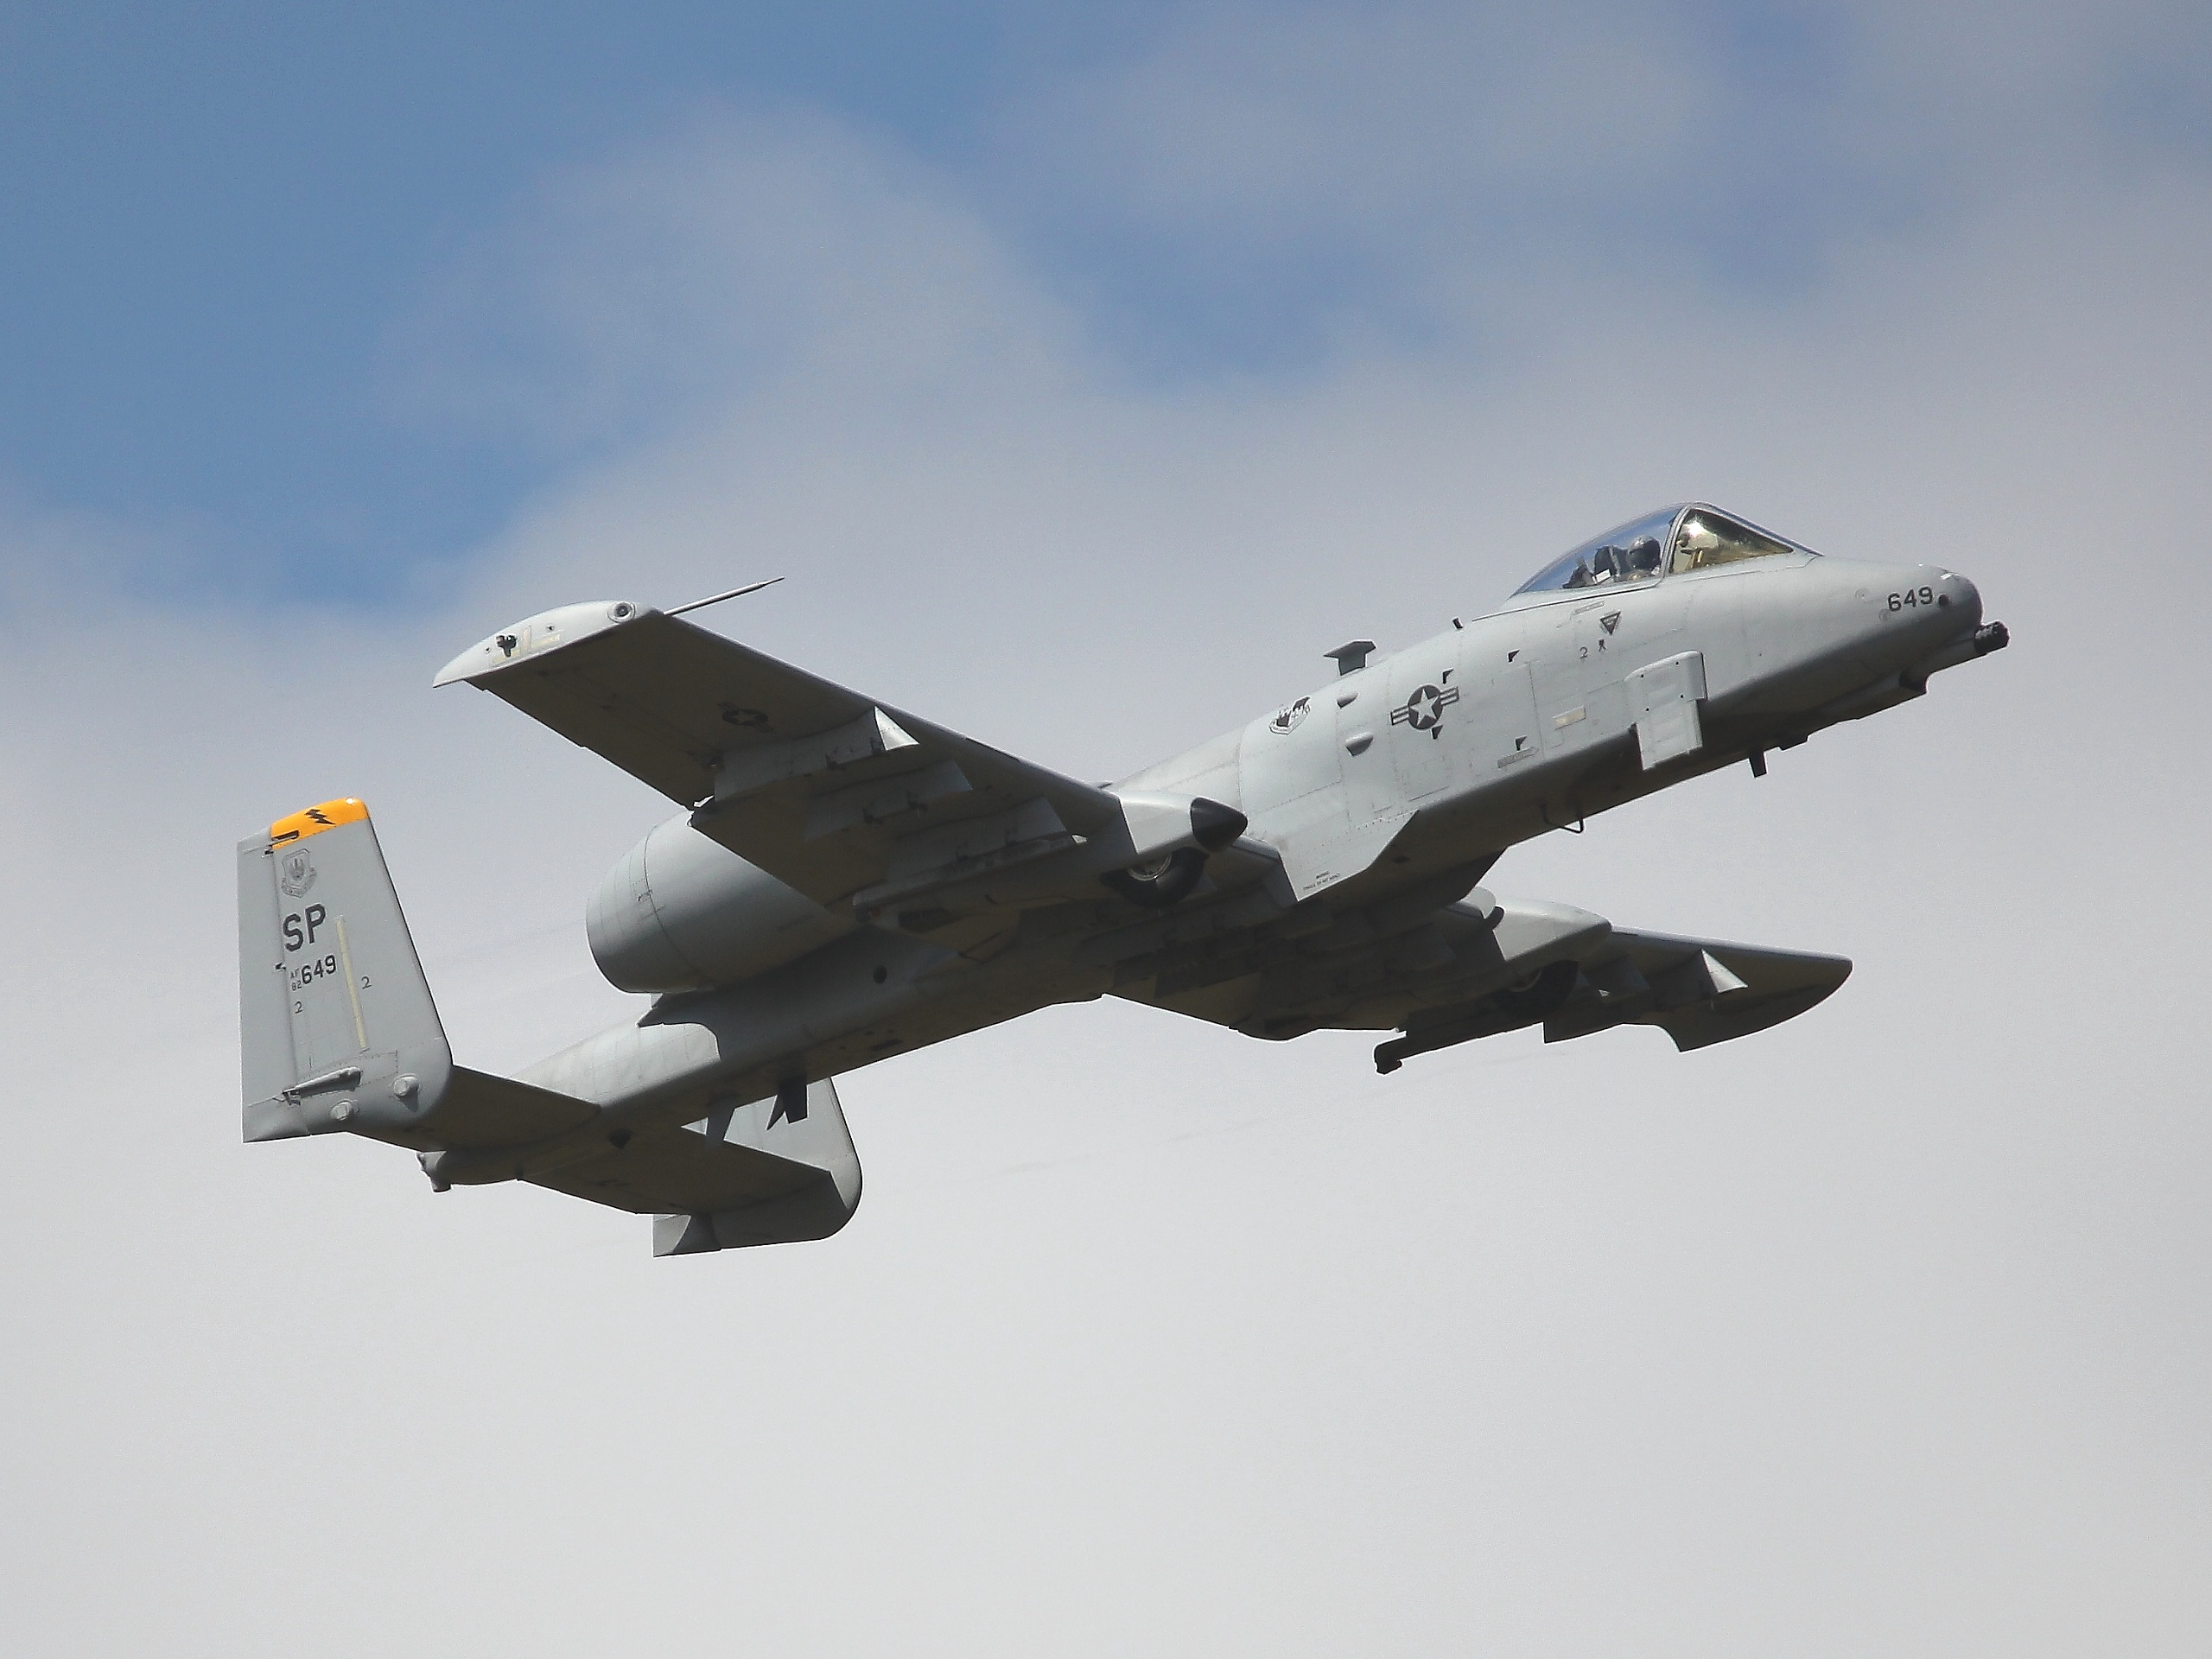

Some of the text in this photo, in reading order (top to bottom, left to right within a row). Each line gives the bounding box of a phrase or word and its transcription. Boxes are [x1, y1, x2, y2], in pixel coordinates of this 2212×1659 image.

[1887, 586, 1933, 612] 649
[1579, 645, 1588, 659] 2
[282, 903, 327, 952] SP
[301, 954, 337, 985] 649
[290, 980, 302, 991] 82
[361, 976, 372, 989] 2
[294, 1001, 303, 1014] 2
